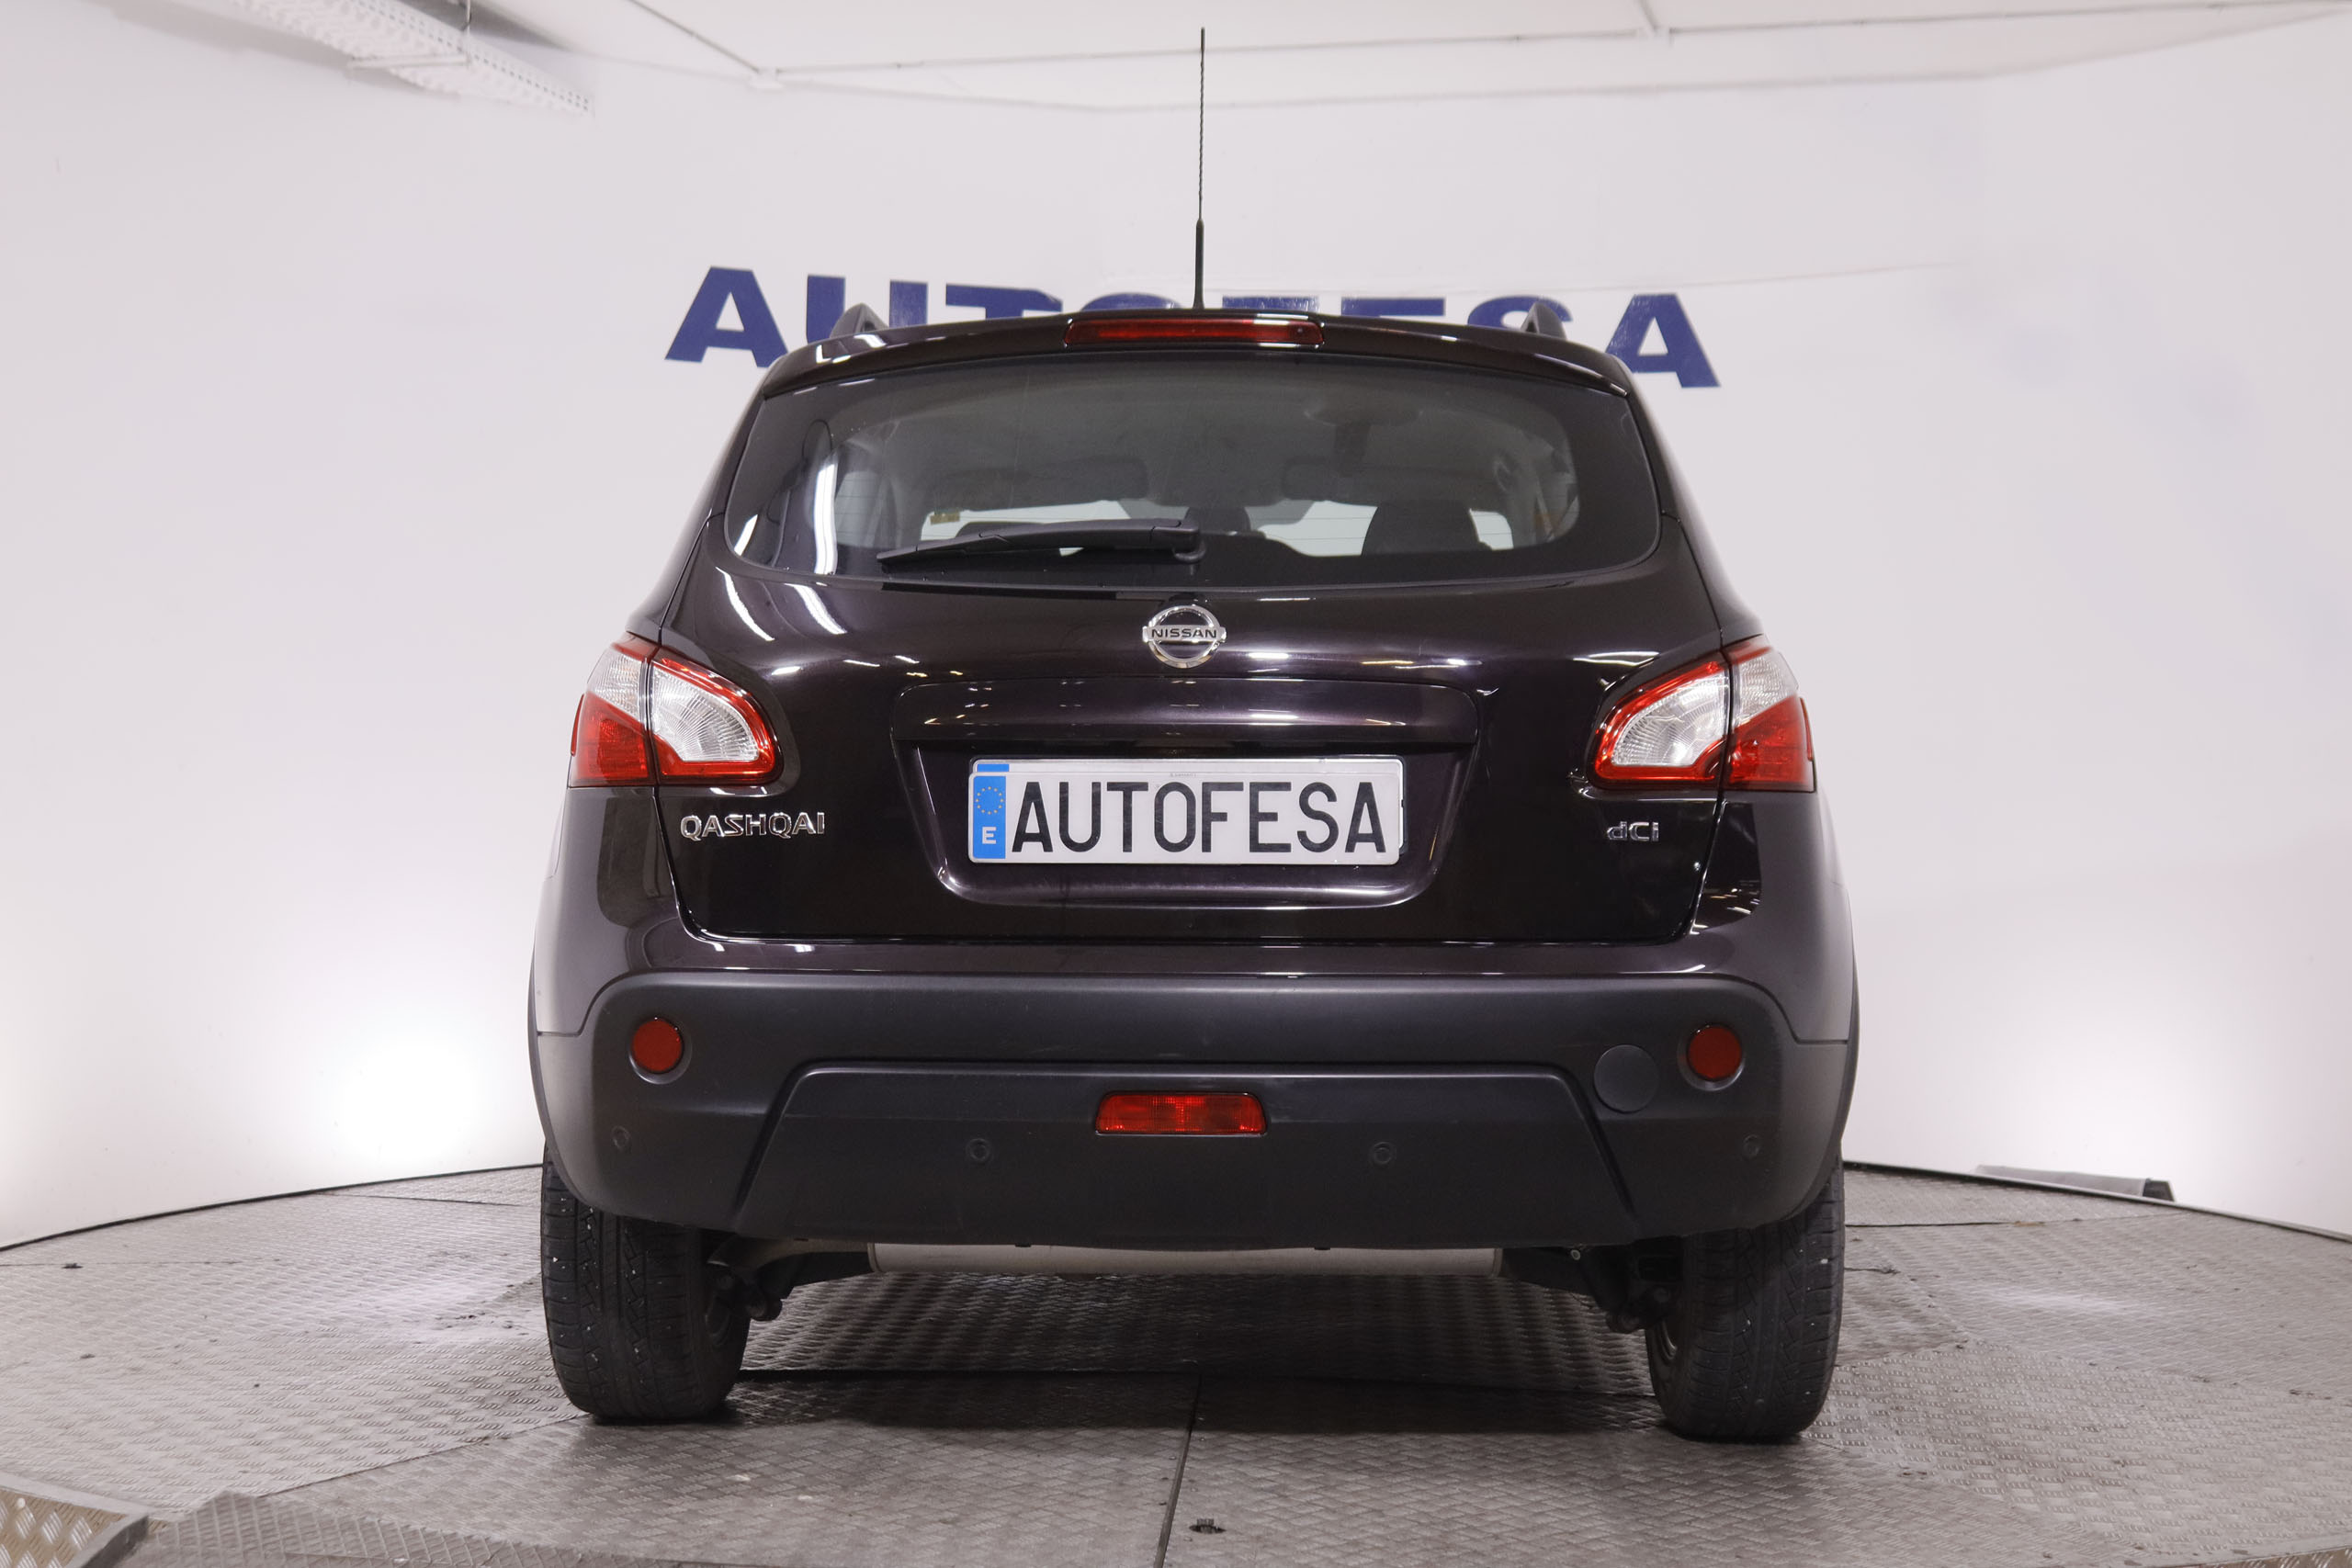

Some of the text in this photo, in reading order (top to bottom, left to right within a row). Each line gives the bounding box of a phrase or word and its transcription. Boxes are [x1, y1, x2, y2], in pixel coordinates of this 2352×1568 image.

[1151, 628, 1217, 639] NISSAN
[680, 812, 825, 841] QASHQAI
[1012, 781, 1386, 852] AUTOFESA
[982, 827, 998, 844] E
[1606, 820, 1660, 842] dCi
